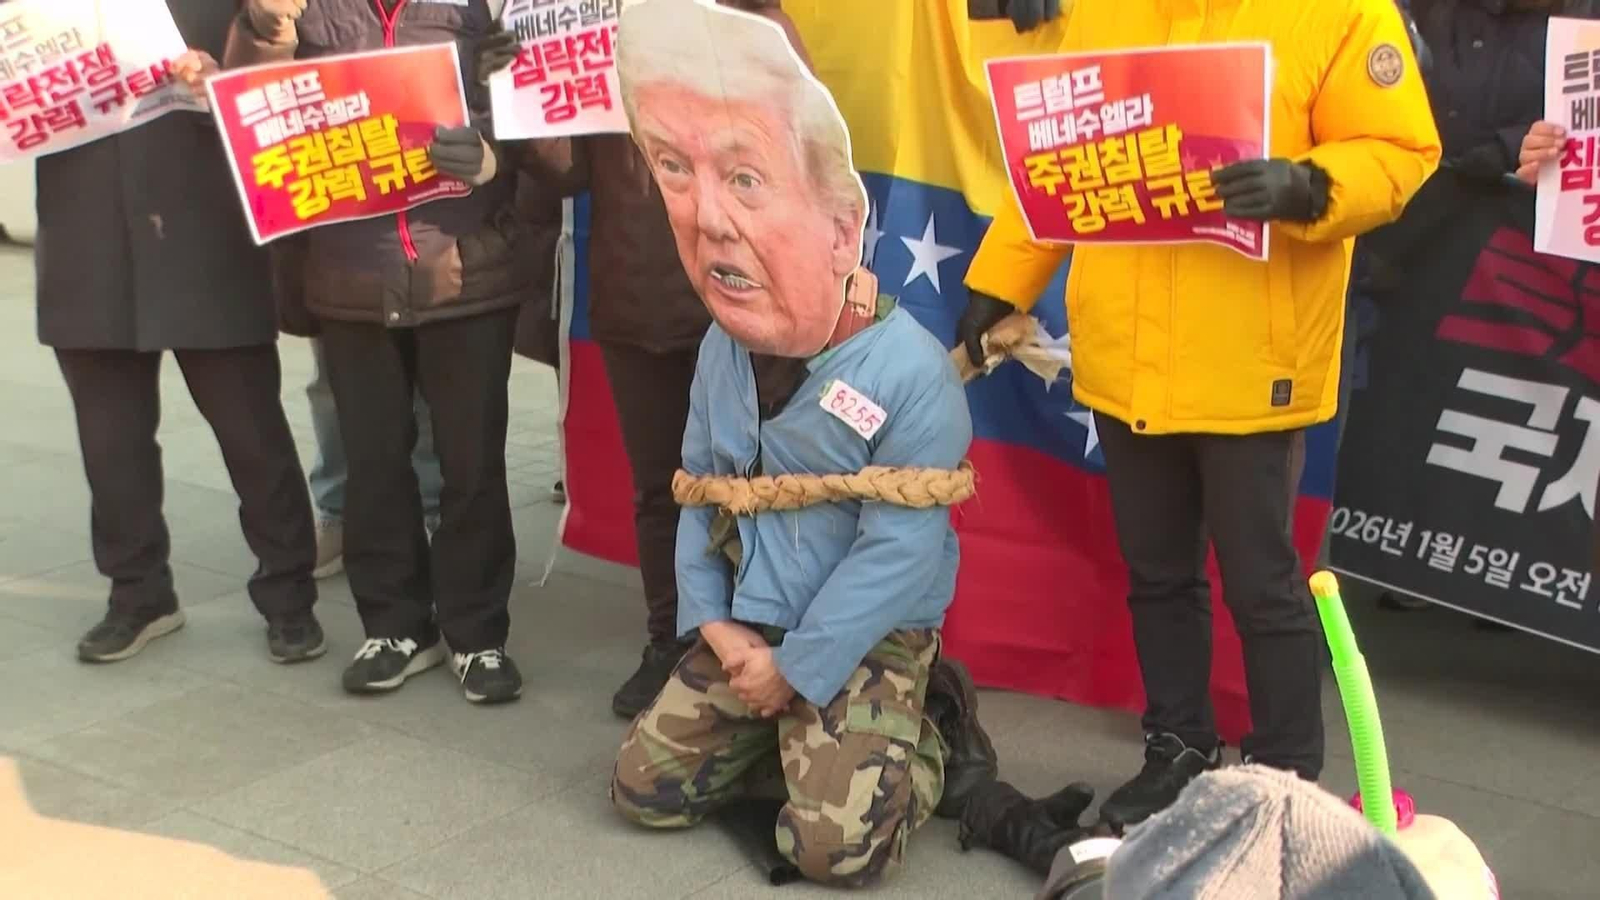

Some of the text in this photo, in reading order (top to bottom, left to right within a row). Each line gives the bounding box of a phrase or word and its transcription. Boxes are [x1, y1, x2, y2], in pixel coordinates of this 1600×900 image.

[0, 42, 120, 120] 략전쟁
[511, 25, 618, 89] 침략전
[235, 70, 326, 127] 트럼프
[254, 90, 370, 148] 베네수엘라
[540, 73, 612, 125] 강력
[1013, 65, 1104, 121] 트럼프
[6, 99, 87, 150] 강력
[1028, 93, 1153, 151] 베네수엘라
[252, 114, 400, 188] 주권침탈
[1024, 123, 1183, 196] 주권침탈
[287, 163, 367, 219] 강력
[1062, 184, 1145, 233] 강력
[831, 389, 881, 432] 8255
[1417, 530, 1464, 573] 1월
[1464, 545, 1520, 590] 5일
[1520, 561, 1592, 611] 오전
